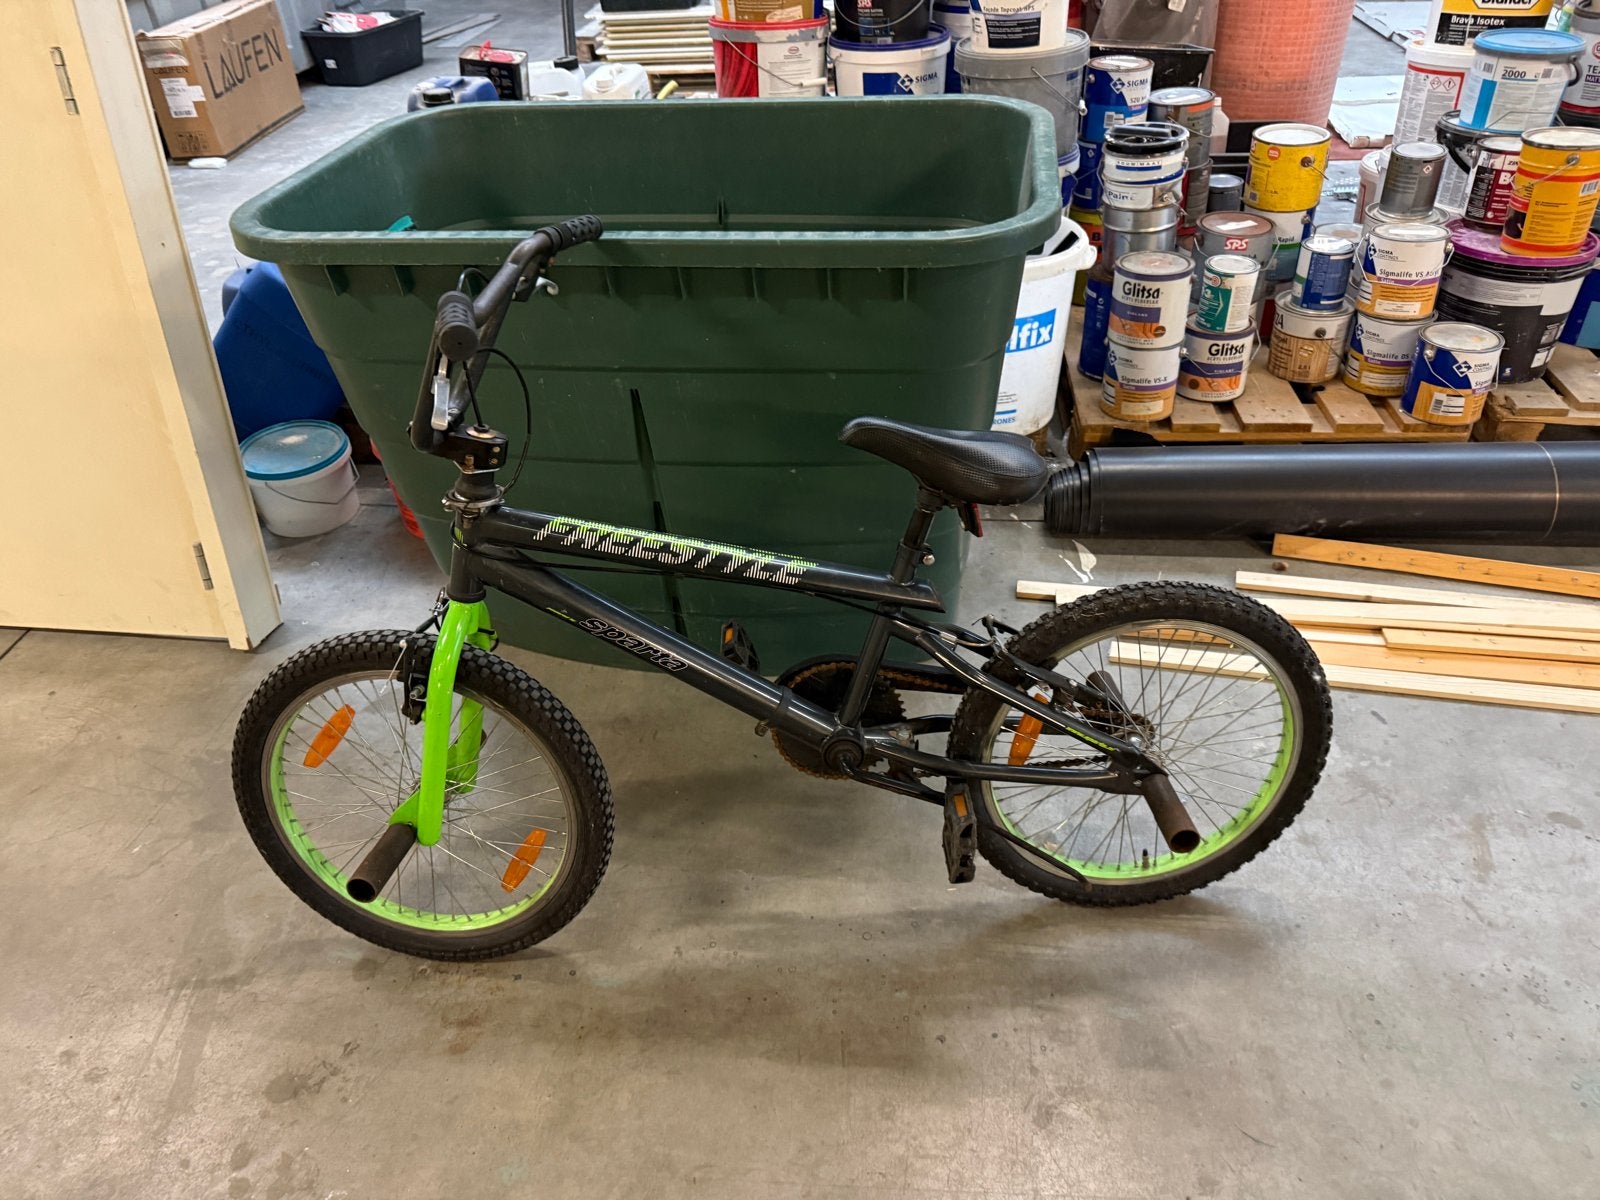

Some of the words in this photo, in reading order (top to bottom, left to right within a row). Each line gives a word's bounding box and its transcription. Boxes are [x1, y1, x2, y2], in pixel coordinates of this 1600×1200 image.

[1450, 14, 1475, 25] Brava
[1476, 16, 1505, 26] Isotex
[203, 28, 283, 100] LAUFEN
[915, 71, 938, 84] SIGMA
[1501, 69, 1527, 79] 2000
[1223, 238, 1249, 251] SPS
[1378, 248, 1394, 256] SIGMA
[1379, 268, 1413, 279] Sigmalife
[1415, 270, 1424, 278] VS
[1122, 280, 1161, 300] Glitsa
[1005, 321, 1053, 351] lfix
[1207, 342, 1245, 357] Glitsa
[1366, 348, 1399, 360] Sigmalife
[1121, 375, 1152, 385] Sigmalife
[533, 515, 819, 586] FREESTYLE
[577, 617, 690, 673] sparta
